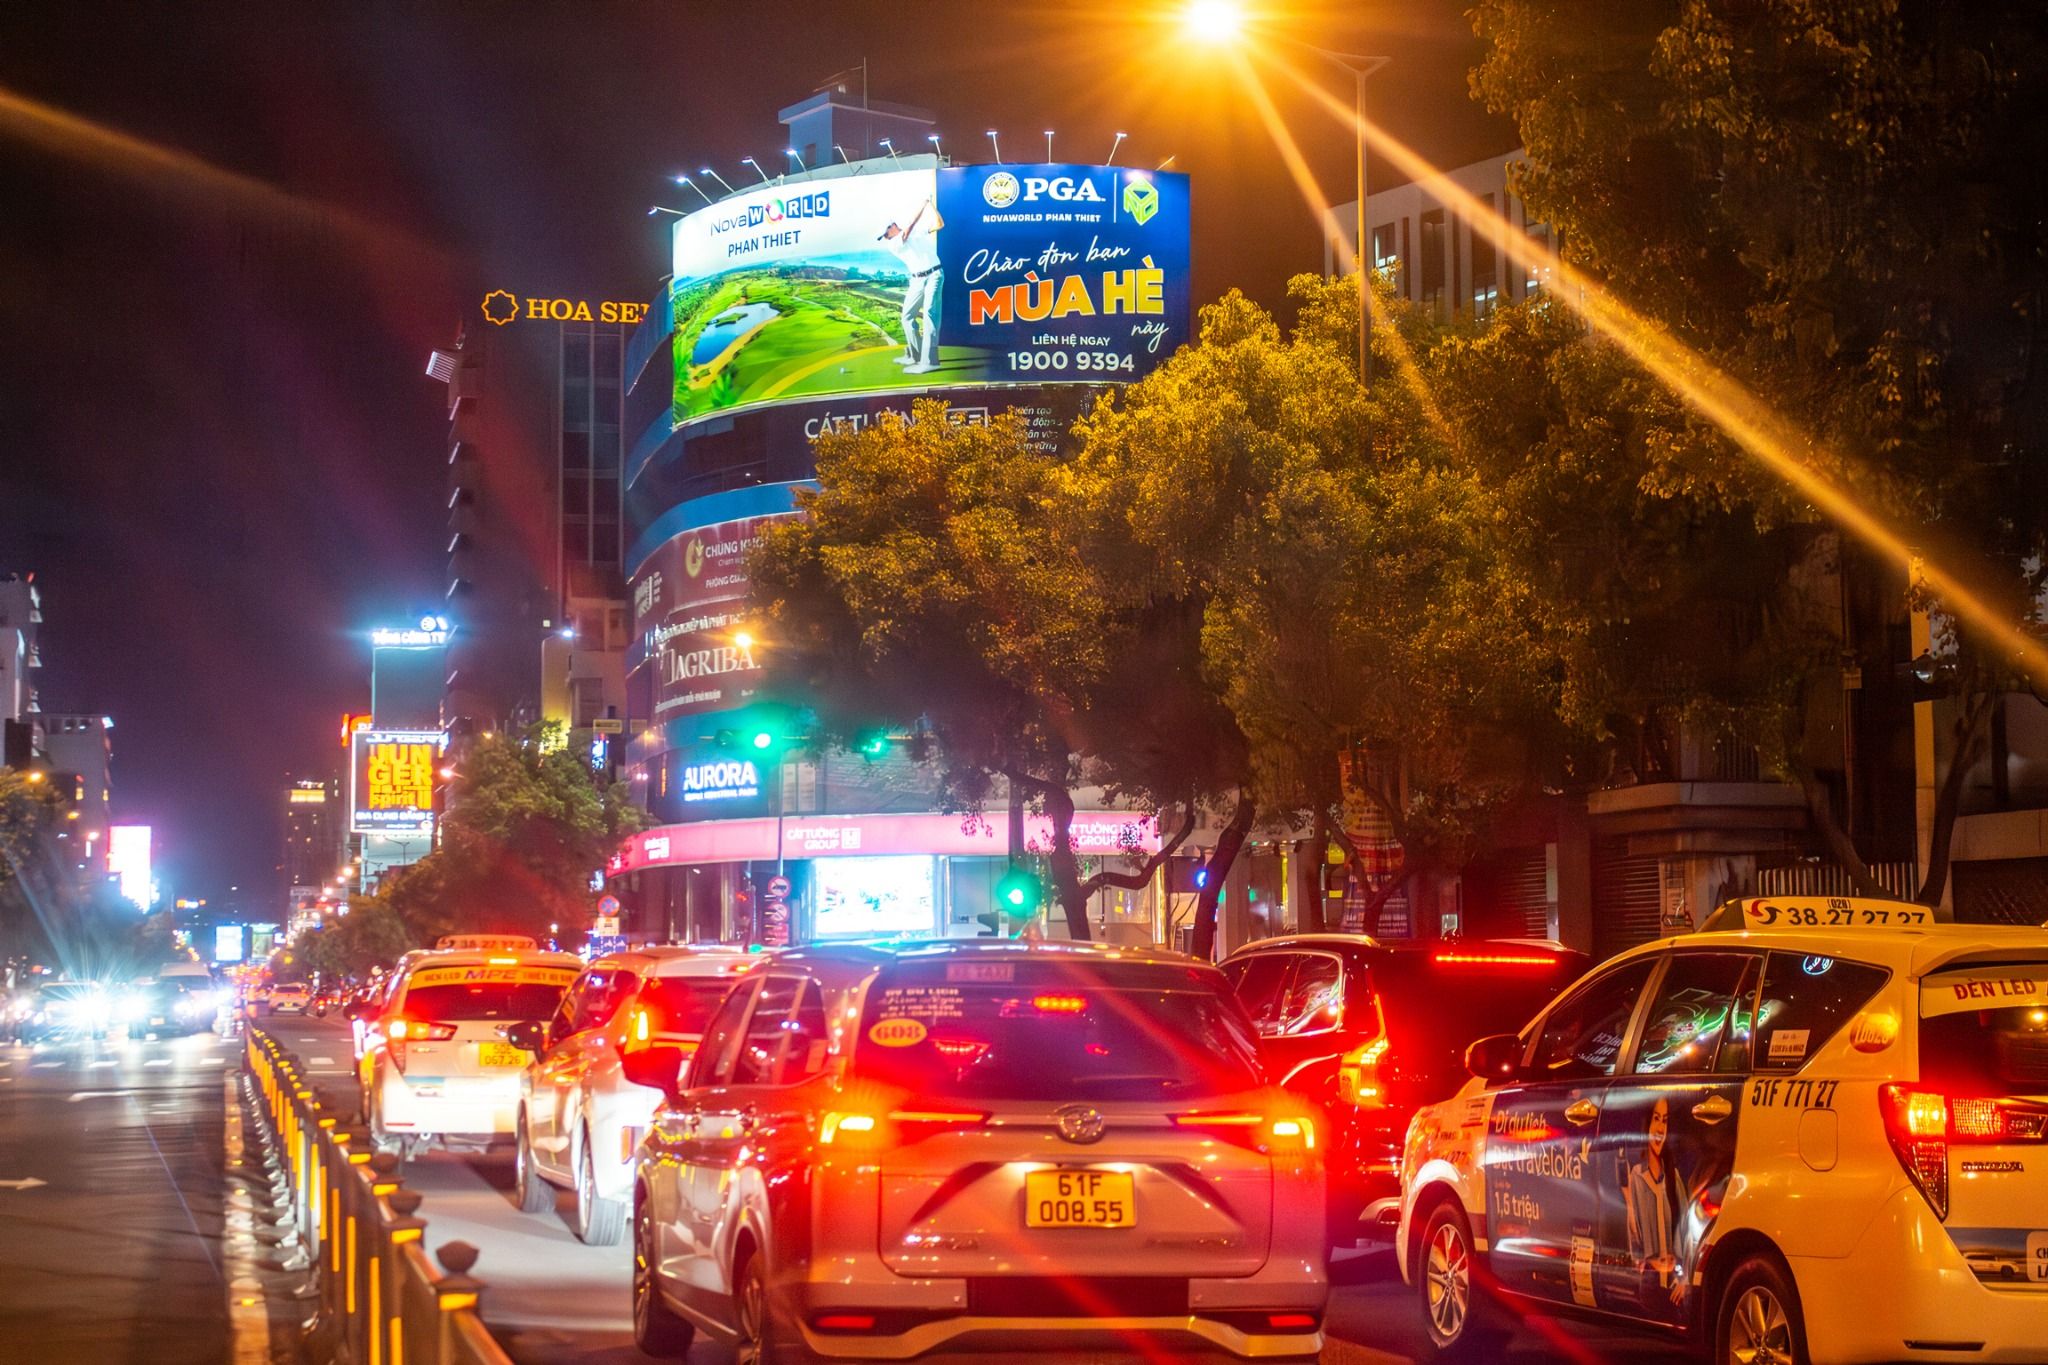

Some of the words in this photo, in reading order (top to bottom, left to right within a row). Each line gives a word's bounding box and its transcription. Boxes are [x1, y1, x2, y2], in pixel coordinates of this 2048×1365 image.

[1023, 177, 1103, 202] PGA
[983, 214, 1042, 223] NOVAWORLD
[1045, 213, 1071, 222] PHAN
[1075, 213, 1101, 223] THIET
[728, 238, 759, 257] PHAN
[762, 230, 801, 248] THIET
[964, 249, 1031, 284] Chào
[1085, 235, 1131, 262] bạn
[969, 270, 1096, 325] MÙA
[1103, 255, 1164, 314] HÈ
[526, 298, 594, 321] HOA
[1032, 334, 1058, 345] LIÊN
[1061, 334, 1077, 347] HỆ
[1080, 337, 1110, 346] NGAY
[1131, 320, 1169, 353] này
[1007, 351, 1069, 371] 1900
[1076, 352, 1135, 372] 9394
[705, 541, 738, 558] CHUNG
[675, 646, 762, 681] AGRIBA
[683, 761, 757, 790] AURORA
[803, 840, 840, 850] GROUP
[1078, 835, 1117, 845] GROUP
[464, 969, 518, 980] MPE
[1999, 978, 2037, 996] LED
[1751, 1079, 1782, 1107] 51F
[1058, 1175, 1102, 1197] 61F
[1039, 1200, 1123, 1223] 008.55
[1511, 1194, 1539, 1225] triệu
